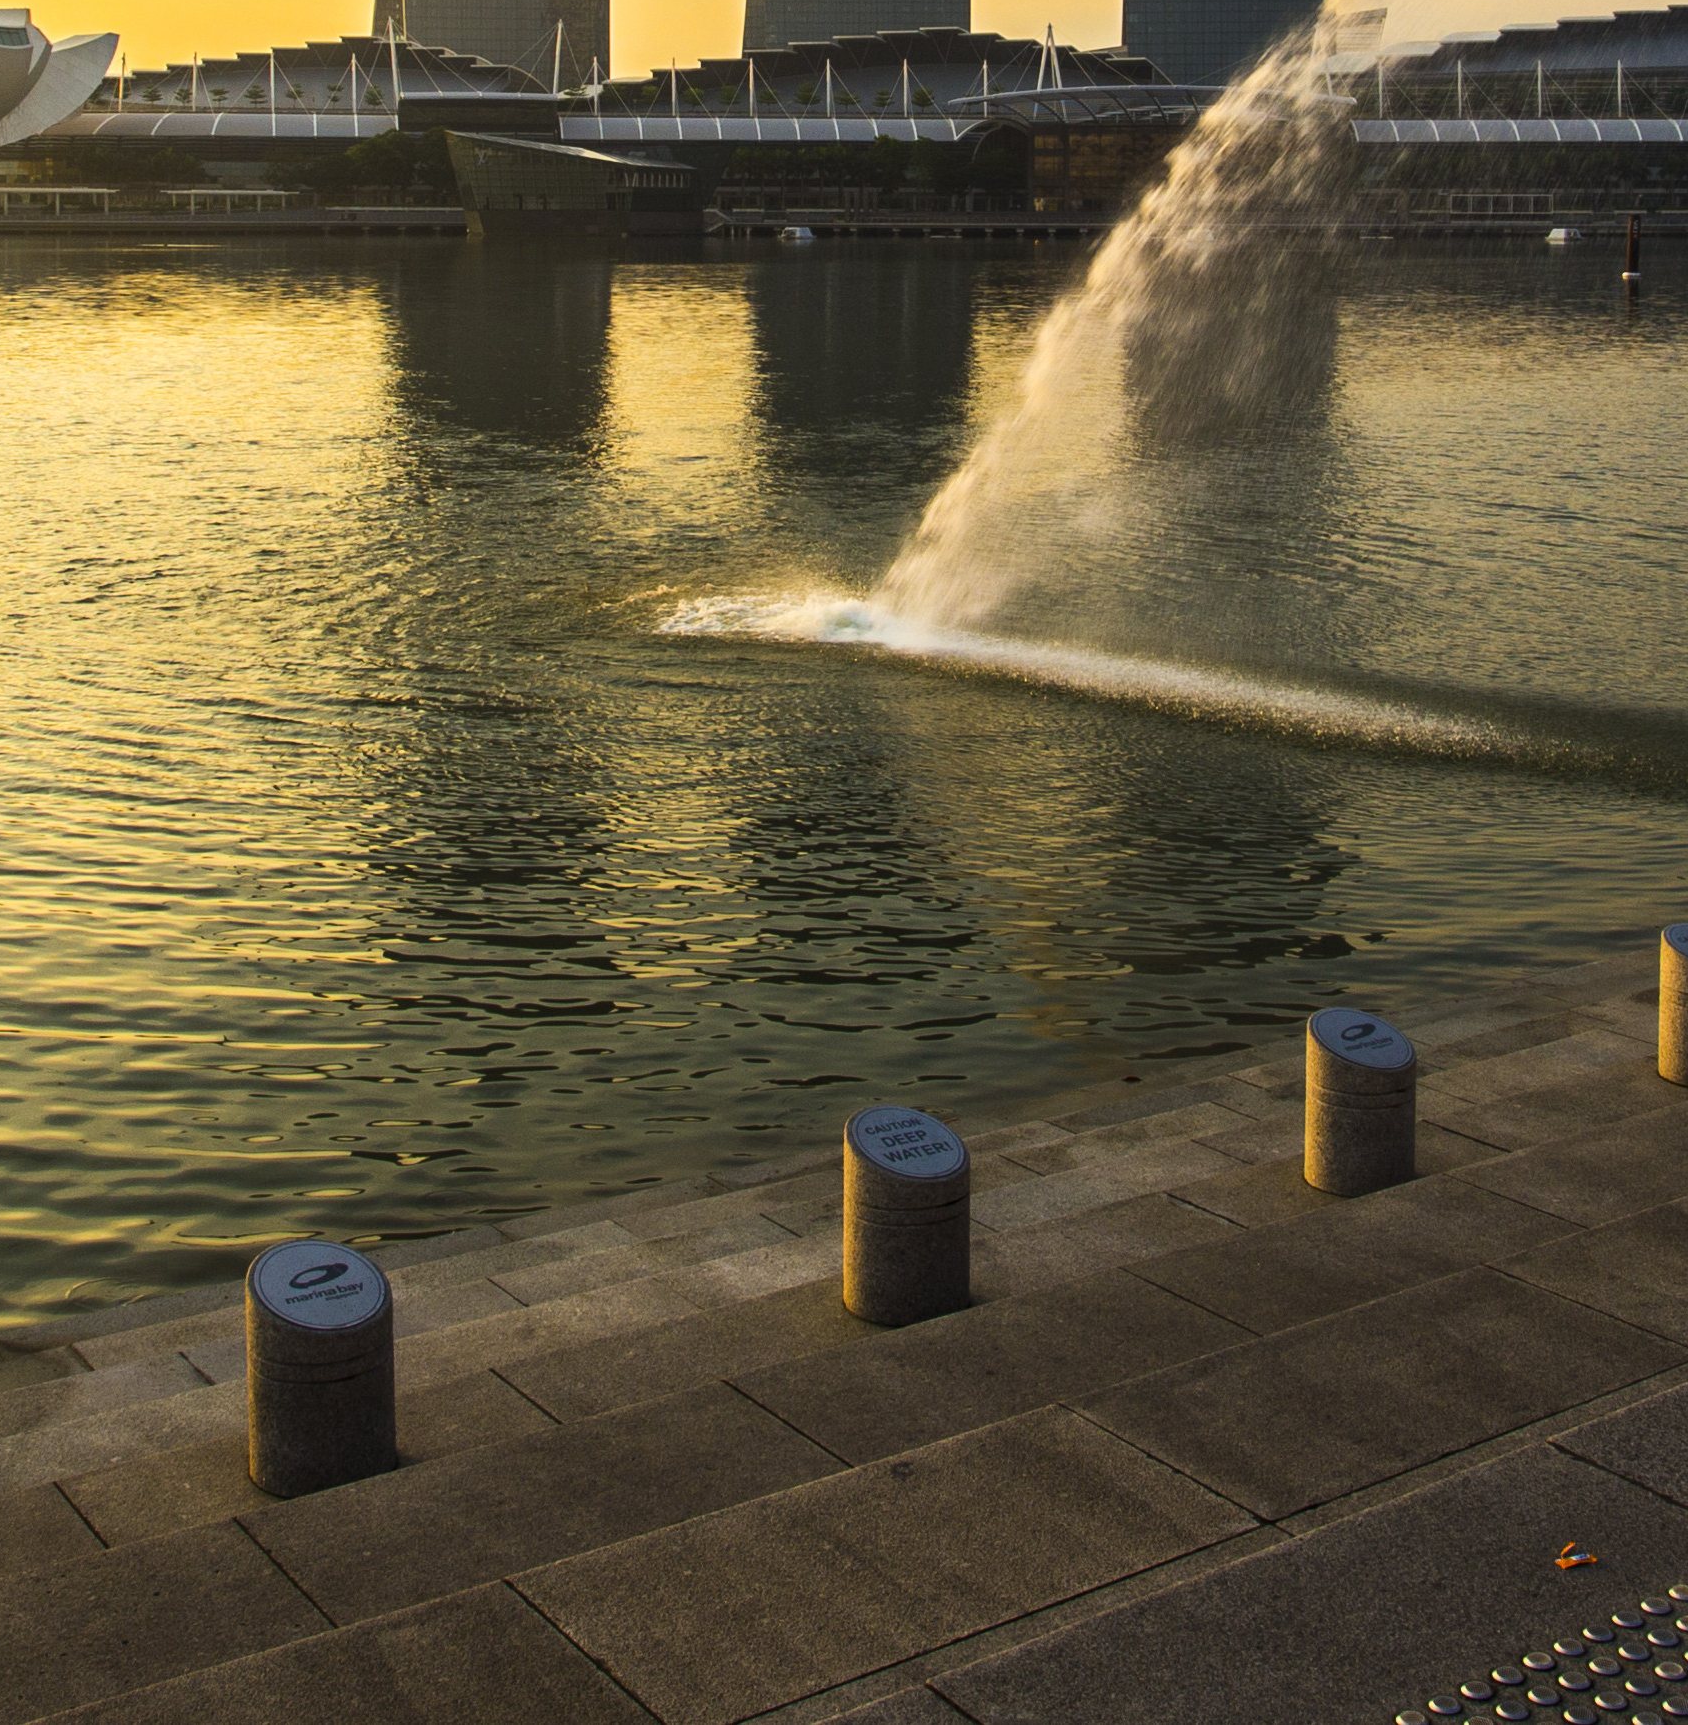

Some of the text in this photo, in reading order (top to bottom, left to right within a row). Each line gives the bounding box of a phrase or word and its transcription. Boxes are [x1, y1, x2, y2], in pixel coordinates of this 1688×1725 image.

[865, 1117, 925, 1135] CAUTION:
[881, 1130, 927, 1148] DEEP
[883, 1141, 954, 1163] WATER!
[285, 1282, 364, 1305] marina bay
